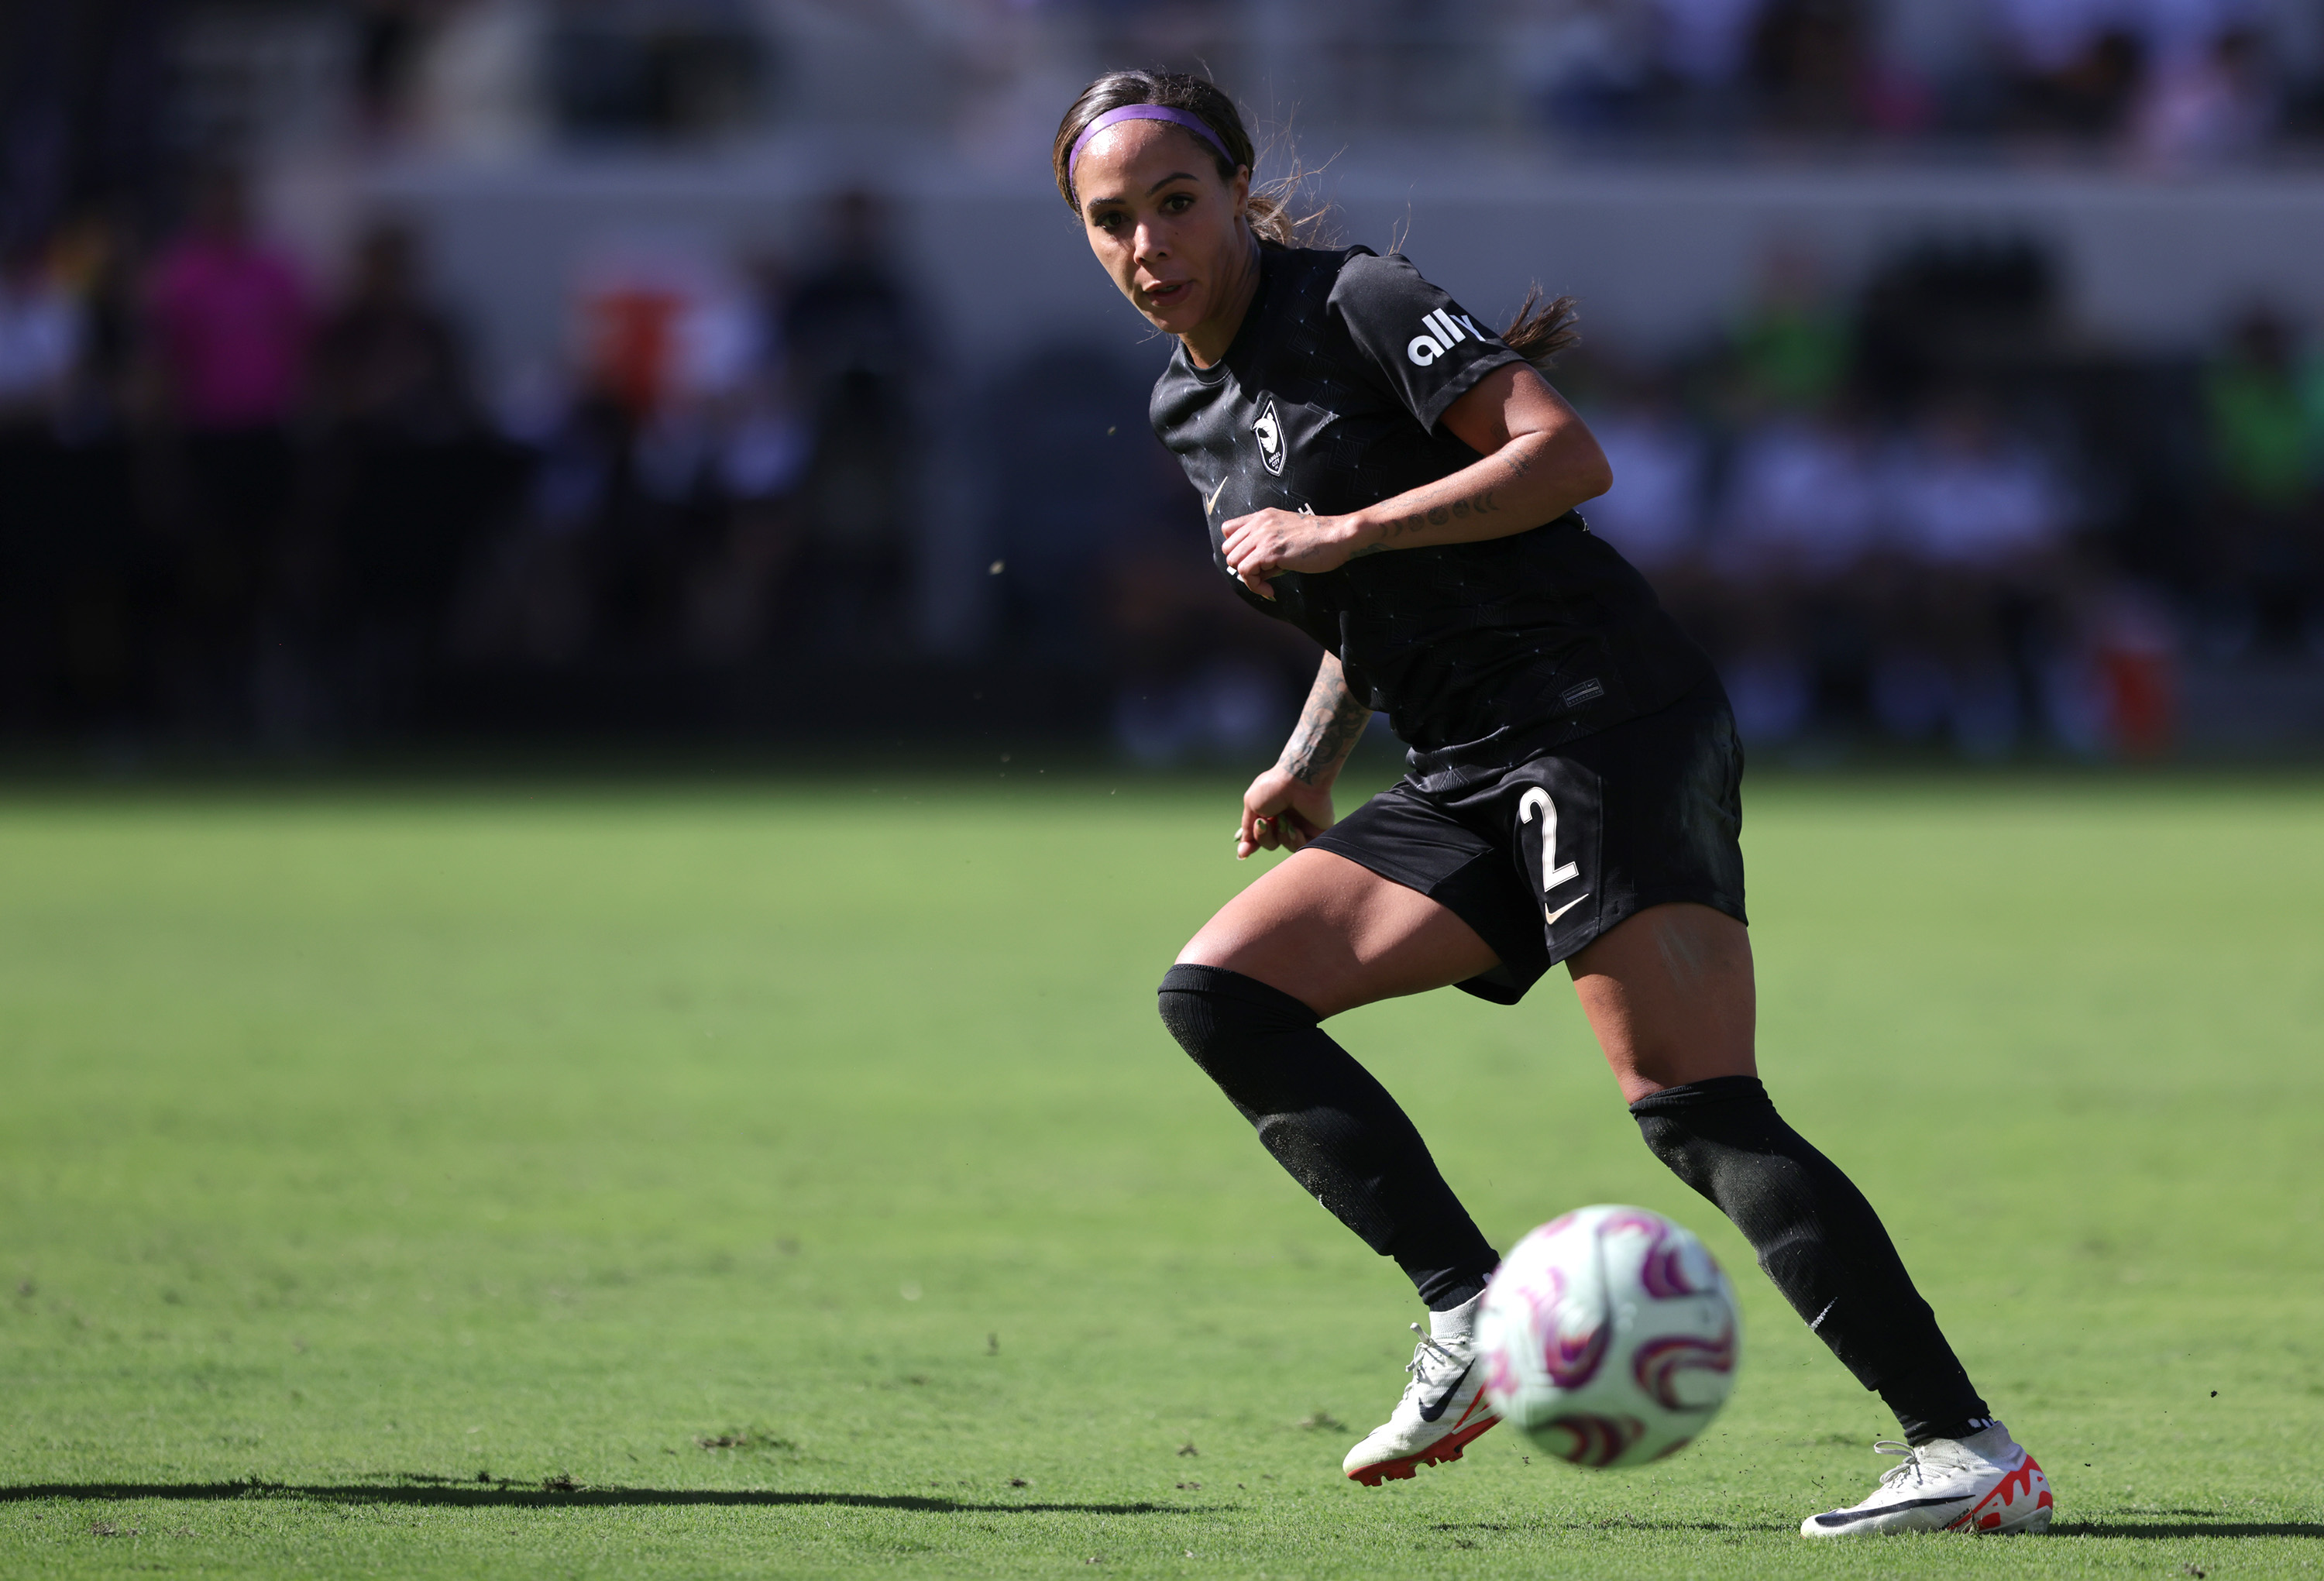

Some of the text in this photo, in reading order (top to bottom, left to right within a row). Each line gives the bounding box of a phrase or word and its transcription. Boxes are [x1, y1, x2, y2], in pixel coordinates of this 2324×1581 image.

[1407, 308, 1486, 366] ally
[1268, 452, 1281, 464] ANGEL
[1271, 458, 1280, 467] CITY
[1519, 786, 1580, 892] 2
